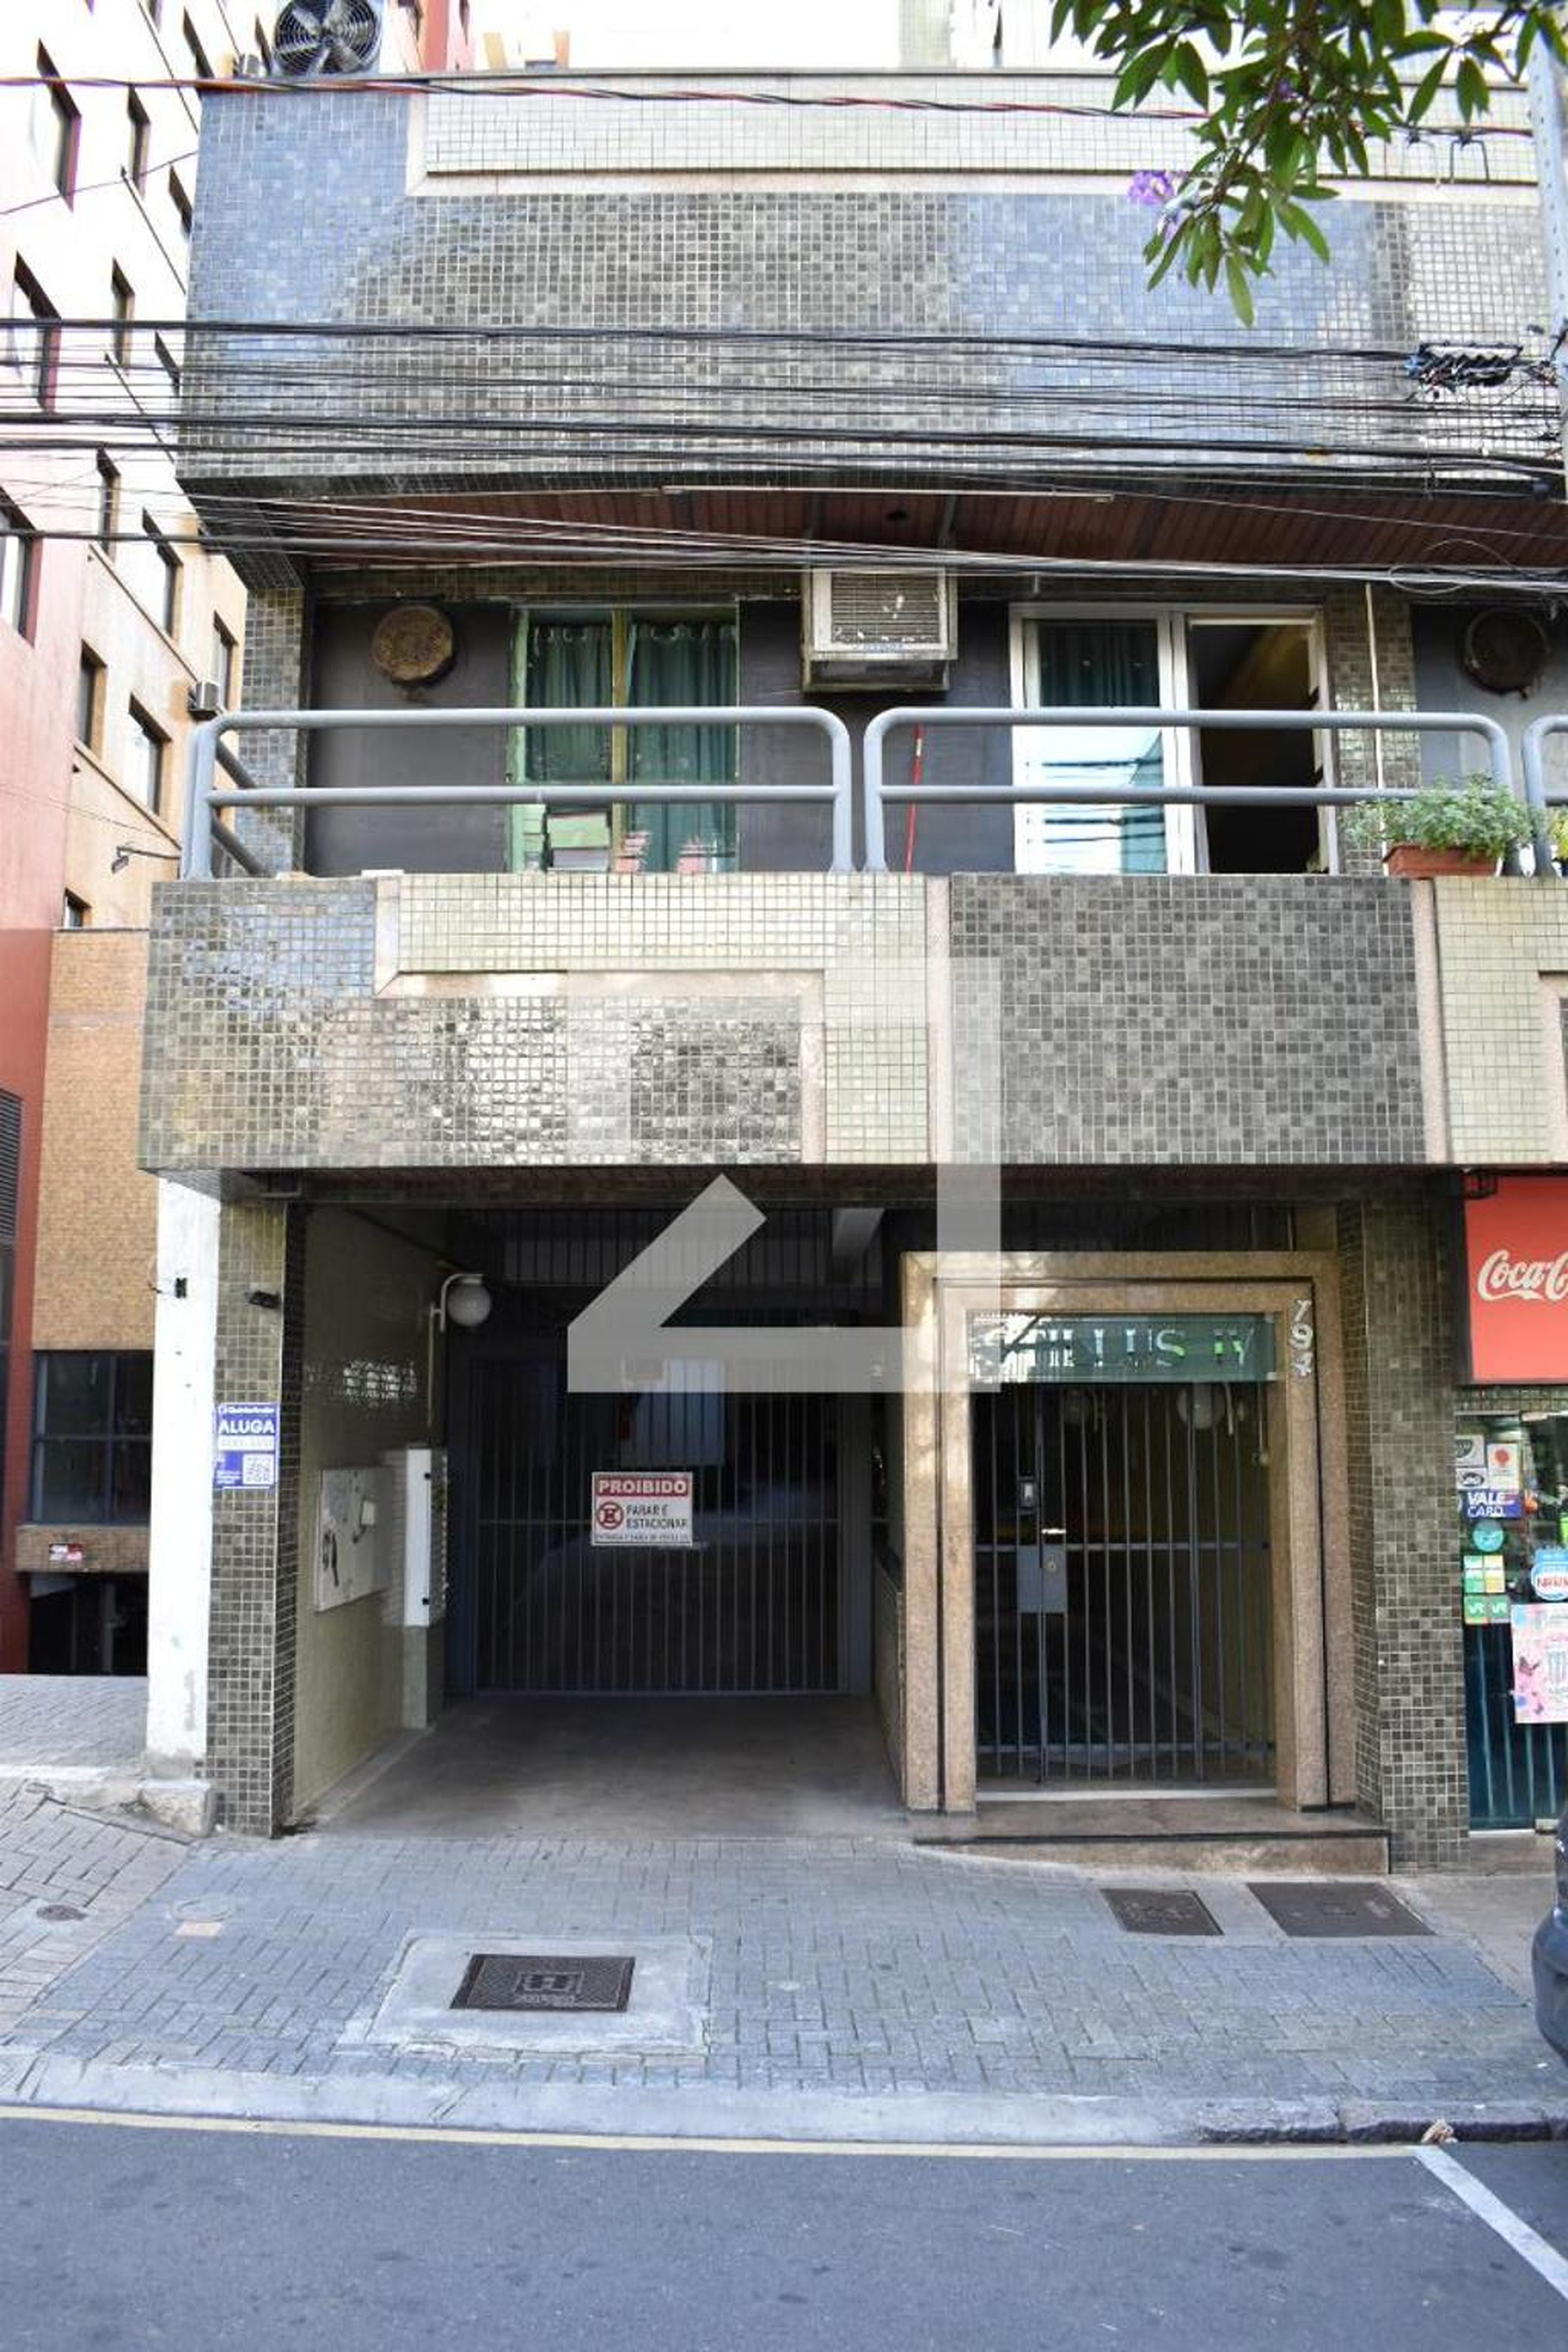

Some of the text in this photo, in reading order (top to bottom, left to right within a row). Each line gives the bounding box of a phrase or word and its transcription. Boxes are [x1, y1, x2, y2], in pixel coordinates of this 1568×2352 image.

[218, 1419, 275, 1434] ALUGA
[599, 1479, 687, 1494] PROIBIDO
[1468, 1492, 1506, 1505] VALE
